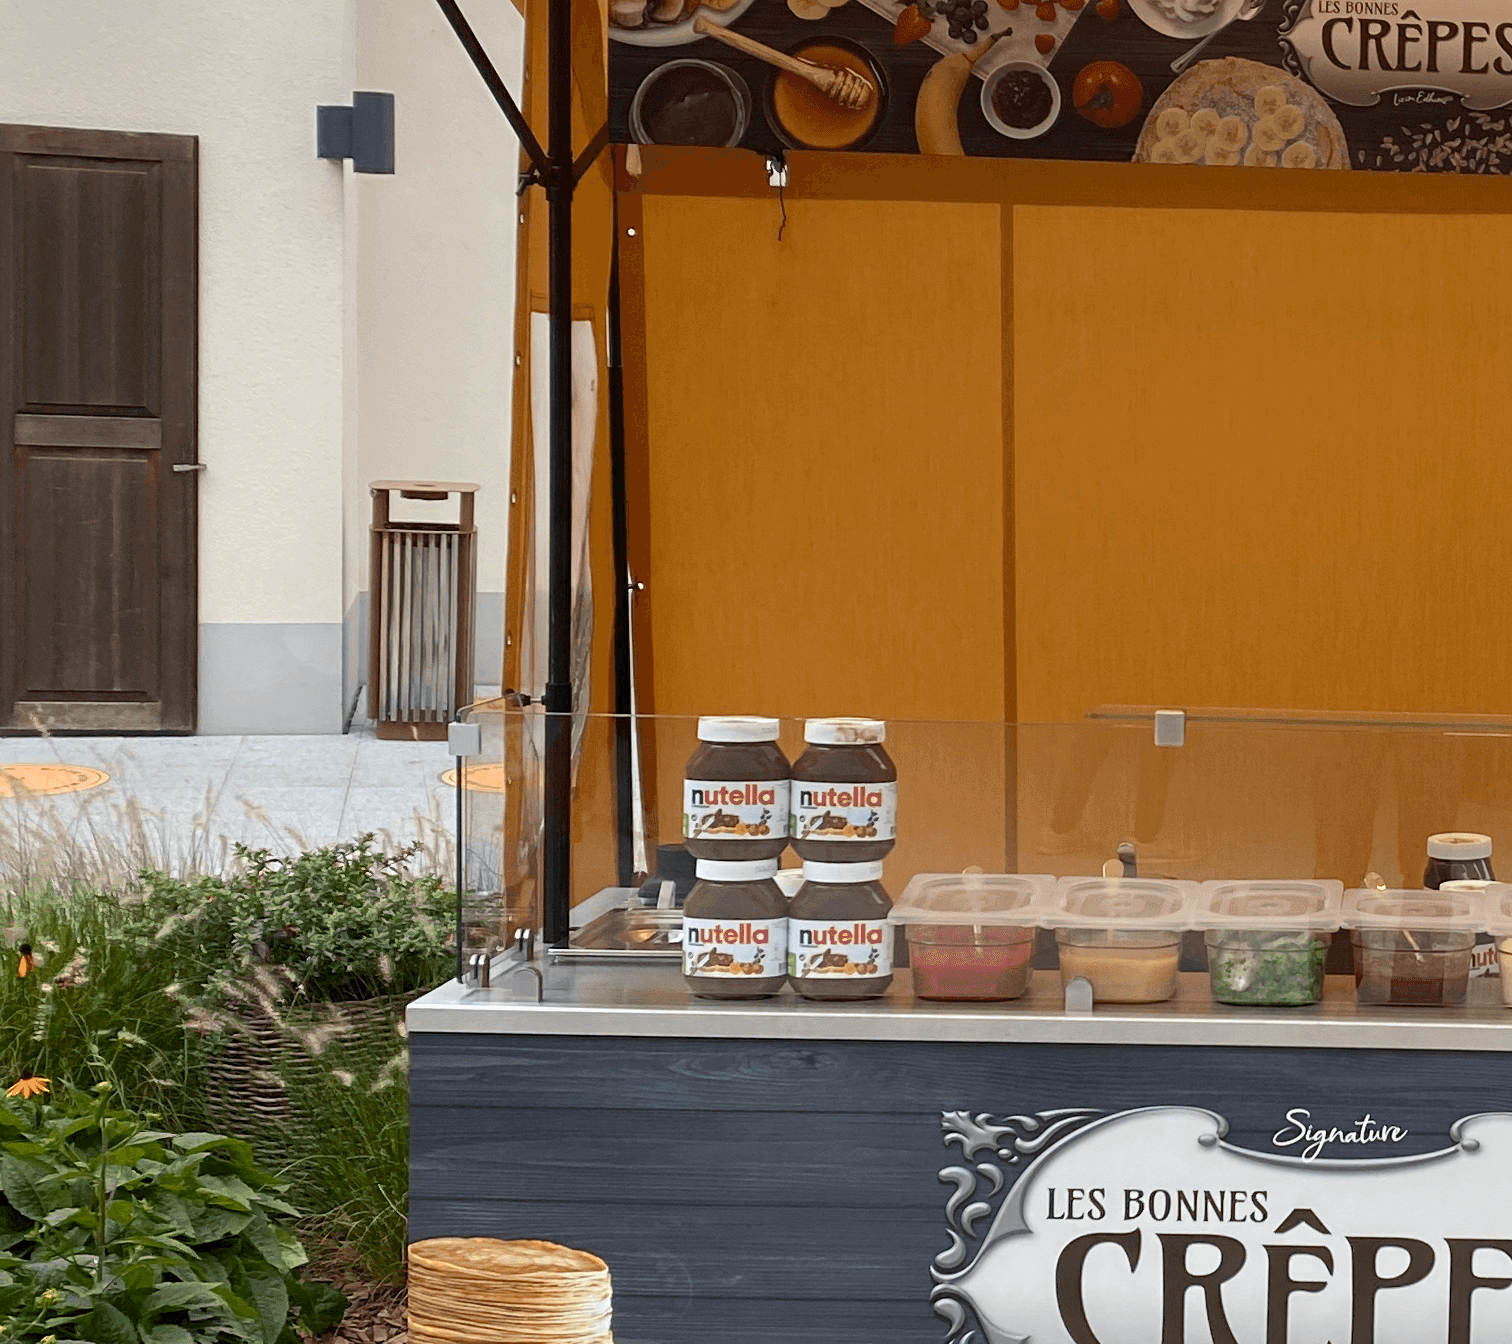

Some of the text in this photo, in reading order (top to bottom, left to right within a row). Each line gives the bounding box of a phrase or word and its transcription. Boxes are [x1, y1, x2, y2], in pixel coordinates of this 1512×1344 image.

[1318, 0, 1399, 16] LES BONNES
[692, 784, 775, 805] nutella
[800, 786, 882, 807] nutella
[688, 923, 769, 944] nutella
[799, 923, 883, 945] nutella
[1272, 1108, 1409, 1162] Signature
[1046, 1187, 1270, 1223] LES BONNES
